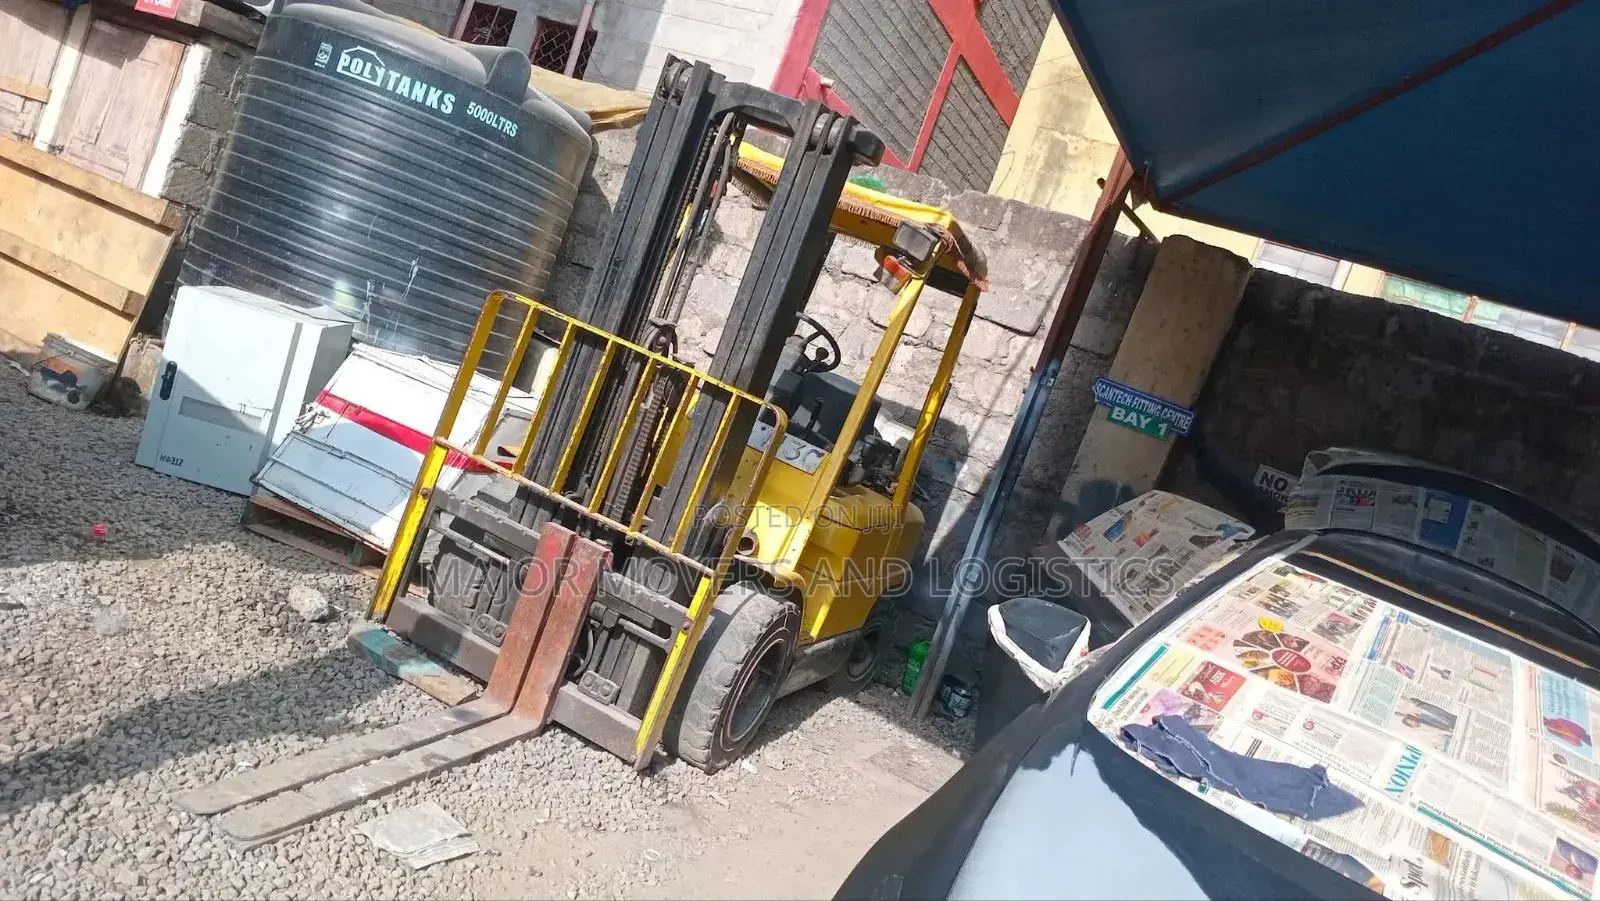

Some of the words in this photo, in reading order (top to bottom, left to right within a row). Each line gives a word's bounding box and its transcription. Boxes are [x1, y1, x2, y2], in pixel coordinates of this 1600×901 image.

[466, 101, 518, 138] 5000LTRS
[1095, 383, 1134, 408] SCANTECH
[1131, 396, 1162, 418] FITTING
[1161, 407, 1192, 430] CENTRE
[1111, 406, 1152, 429] BAY
[1158, 423, 1168, 436] 1
[1259, 471, 1288, 491] NO
